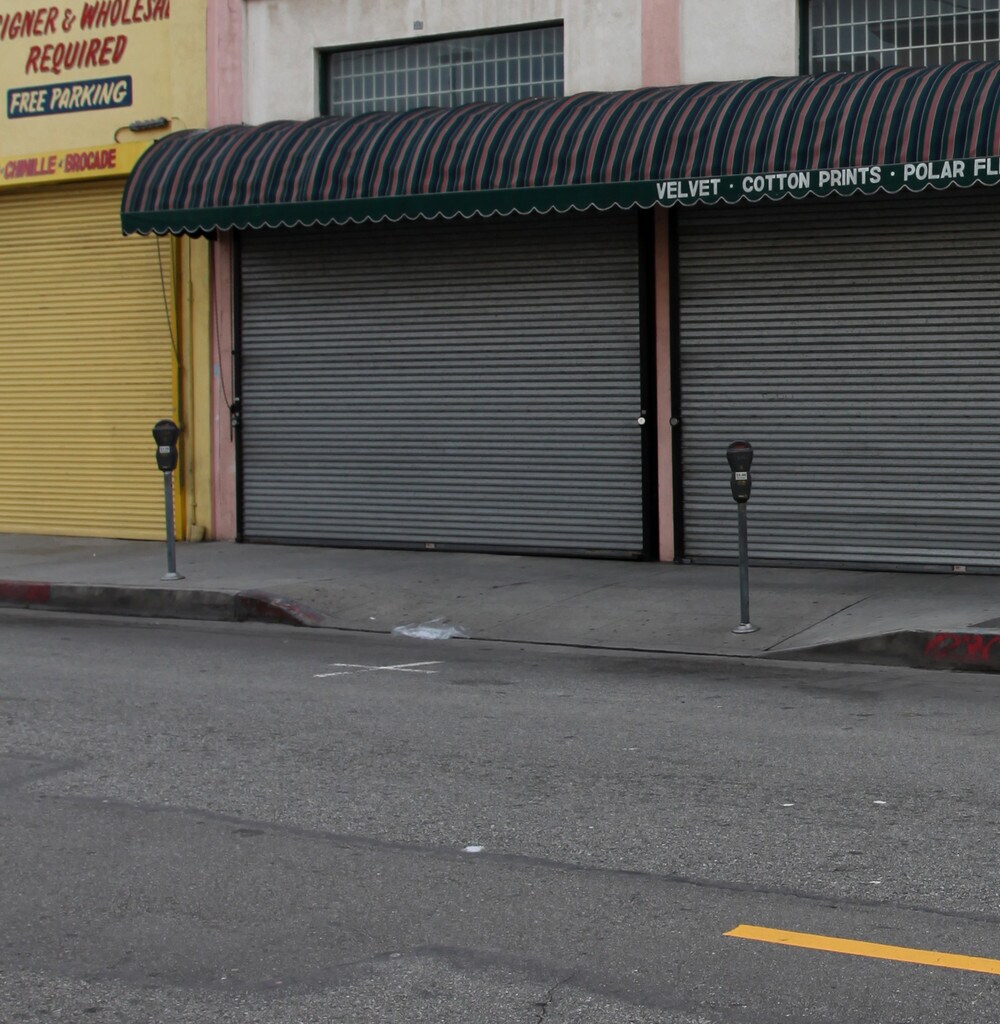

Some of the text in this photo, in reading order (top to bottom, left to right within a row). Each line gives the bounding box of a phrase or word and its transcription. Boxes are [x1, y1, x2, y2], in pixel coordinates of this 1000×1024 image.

[0, 6, 59, 41] IGNER
[62, 8, 76, 33] &
[25, 34, 128, 75] REQUIRED
[10, 80, 128, 114] FREE PARKING
[64, 148, 117, 173] BROCADE
[656, 178, 721, 199] VELVET
[742, 171, 811, 193] COTTON
[818, 166, 882, 187] PRINTS
[903, 160, 965, 181] POLAR
